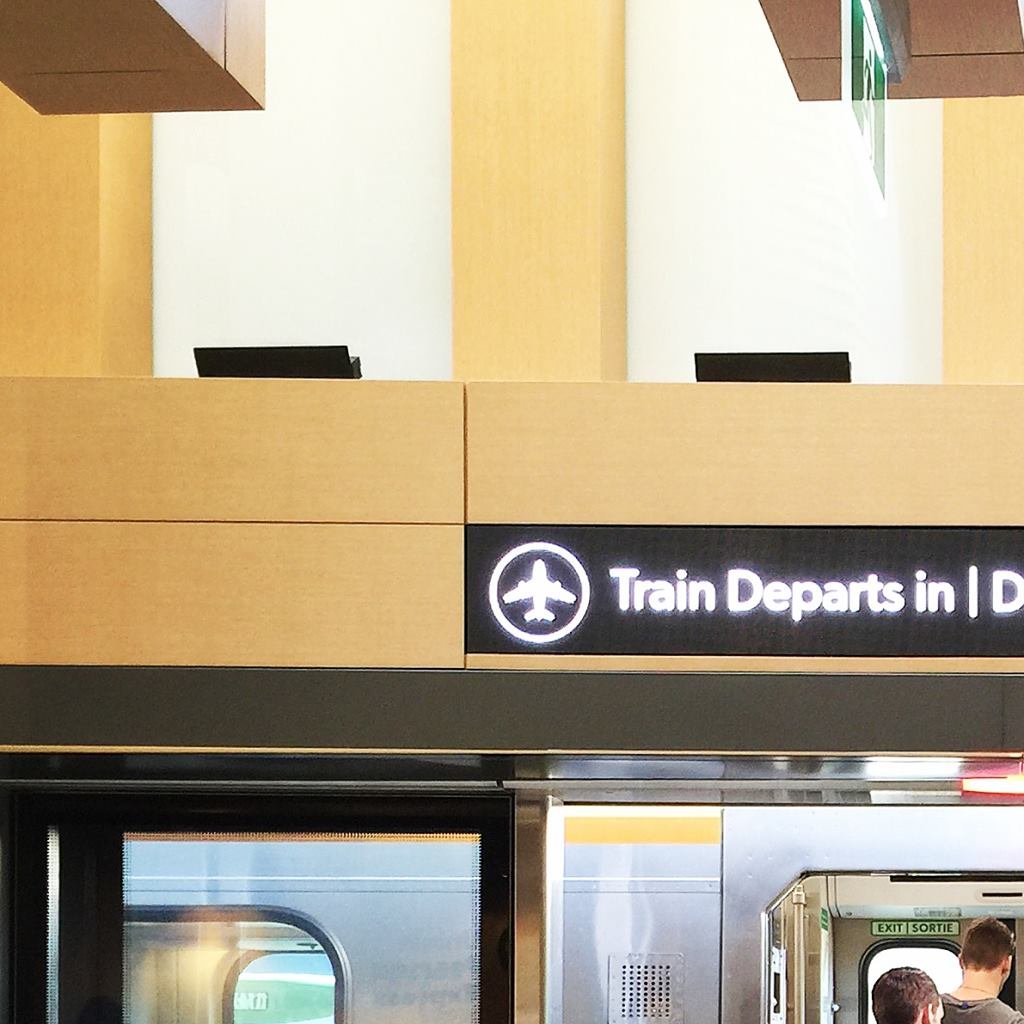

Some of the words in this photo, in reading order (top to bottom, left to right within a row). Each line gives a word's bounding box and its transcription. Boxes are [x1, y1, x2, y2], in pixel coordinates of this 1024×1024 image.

[608, 567, 716, 613] Train
[726, 568, 906, 623] Departs
[914, 569, 956, 613] in
[877, 923, 904, 933] EXIT
[912, 923, 954, 933] SORTIE
